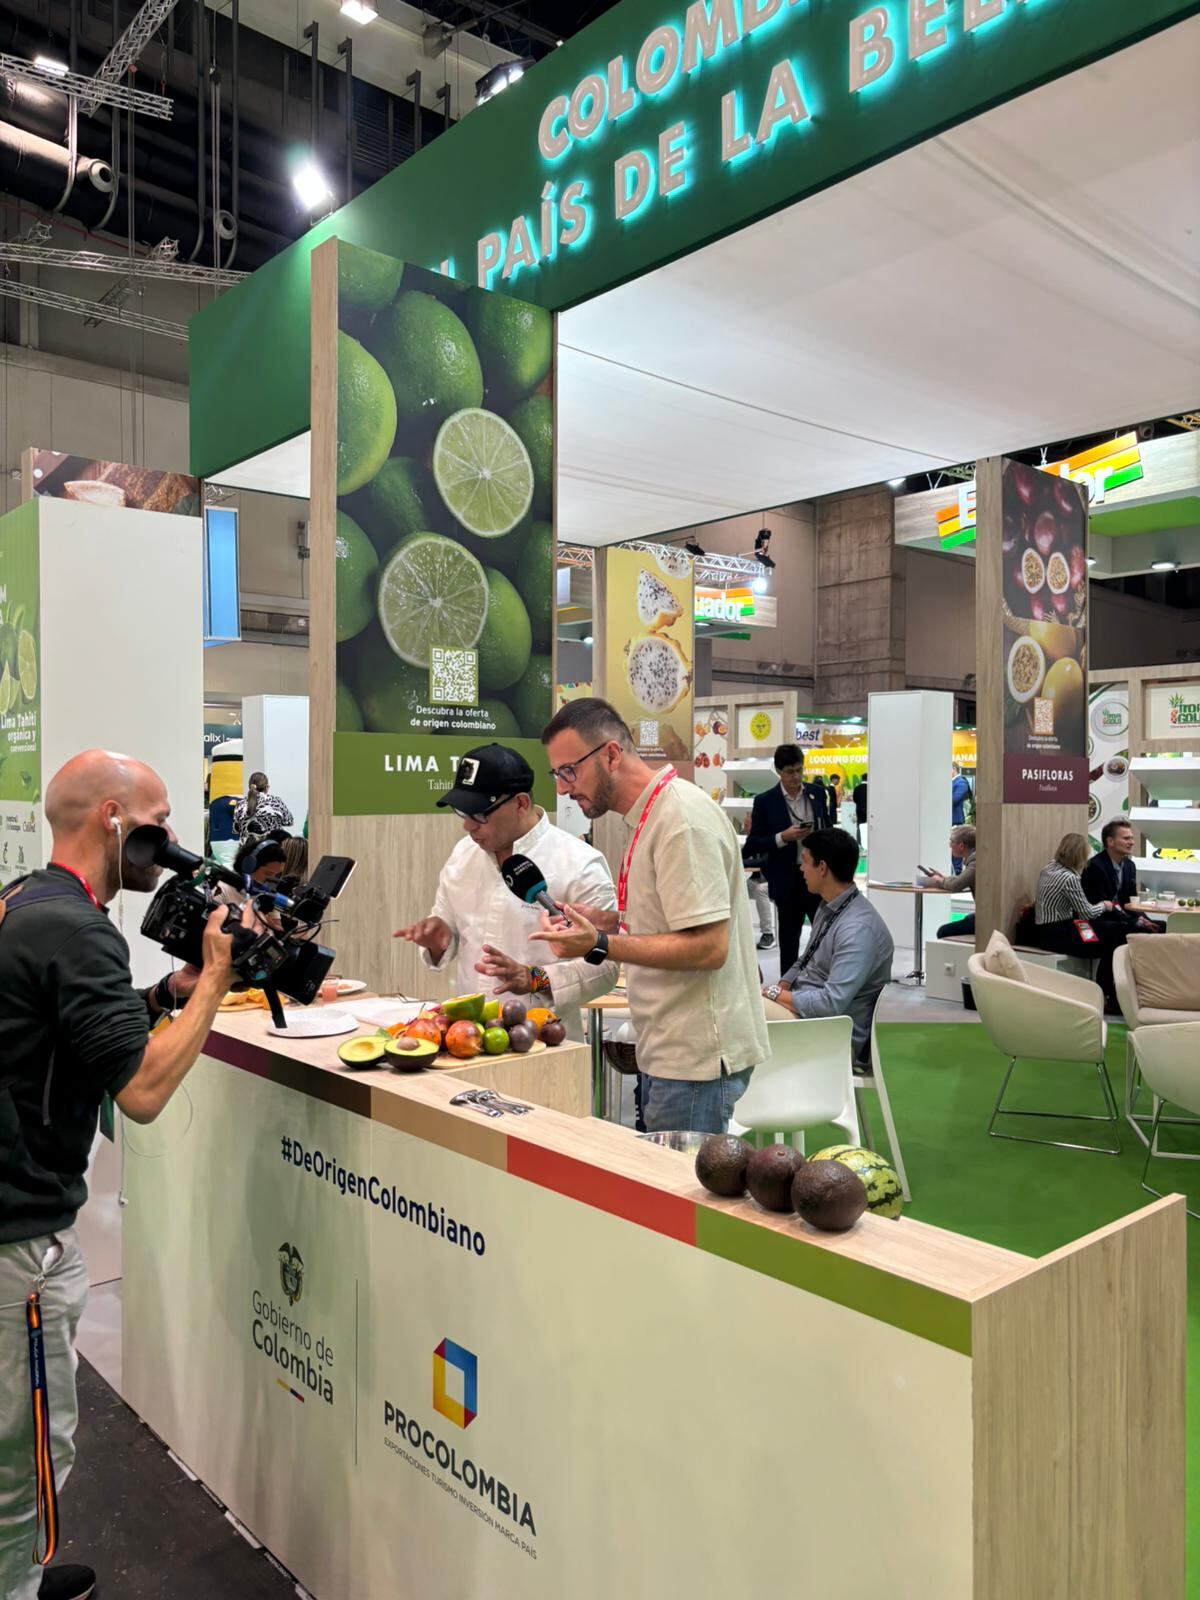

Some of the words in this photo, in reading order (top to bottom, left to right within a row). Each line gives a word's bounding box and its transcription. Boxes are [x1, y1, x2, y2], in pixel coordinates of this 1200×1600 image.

[477, 180, 588, 288] PAÍS
[614, 121, 687, 220] DE
[721, 58, 809, 162] LA
[410, 717, 421, 726] de
[423, 718, 449, 728] origen
[451, 720, 497, 730] colombiano
[416, 704, 454, 716] Descubra
[456, 708, 463, 716] la
[465, 708, 489, 717] oferta
[203, 732, 221, 742] alix
[809, 755, 849, 765] LOOKING
[384, 754, 440, 773] LIMA
[1022, 768, 1074, 781] PASIFLORAS
[281, 1135, 486, 1256] #DeOrigenColombiano
[252, 1290, 312, 1350] Gobierno
[315, 1335, 334, 1367] de
[252, 1319, 334, 1405] Colombia
[384, 1400, 537, 1537] PROCOLOMBIA
[384, 1437, 430, 1478] EXPORTACIONES
[431, 1471, 458, 1499] TURISMO
[458, 1493, 494, 1527] INVERSIÓN
[494, 1520, 520, 1548] MARCA
[520, 1541, 537, 1560] PAÍS
